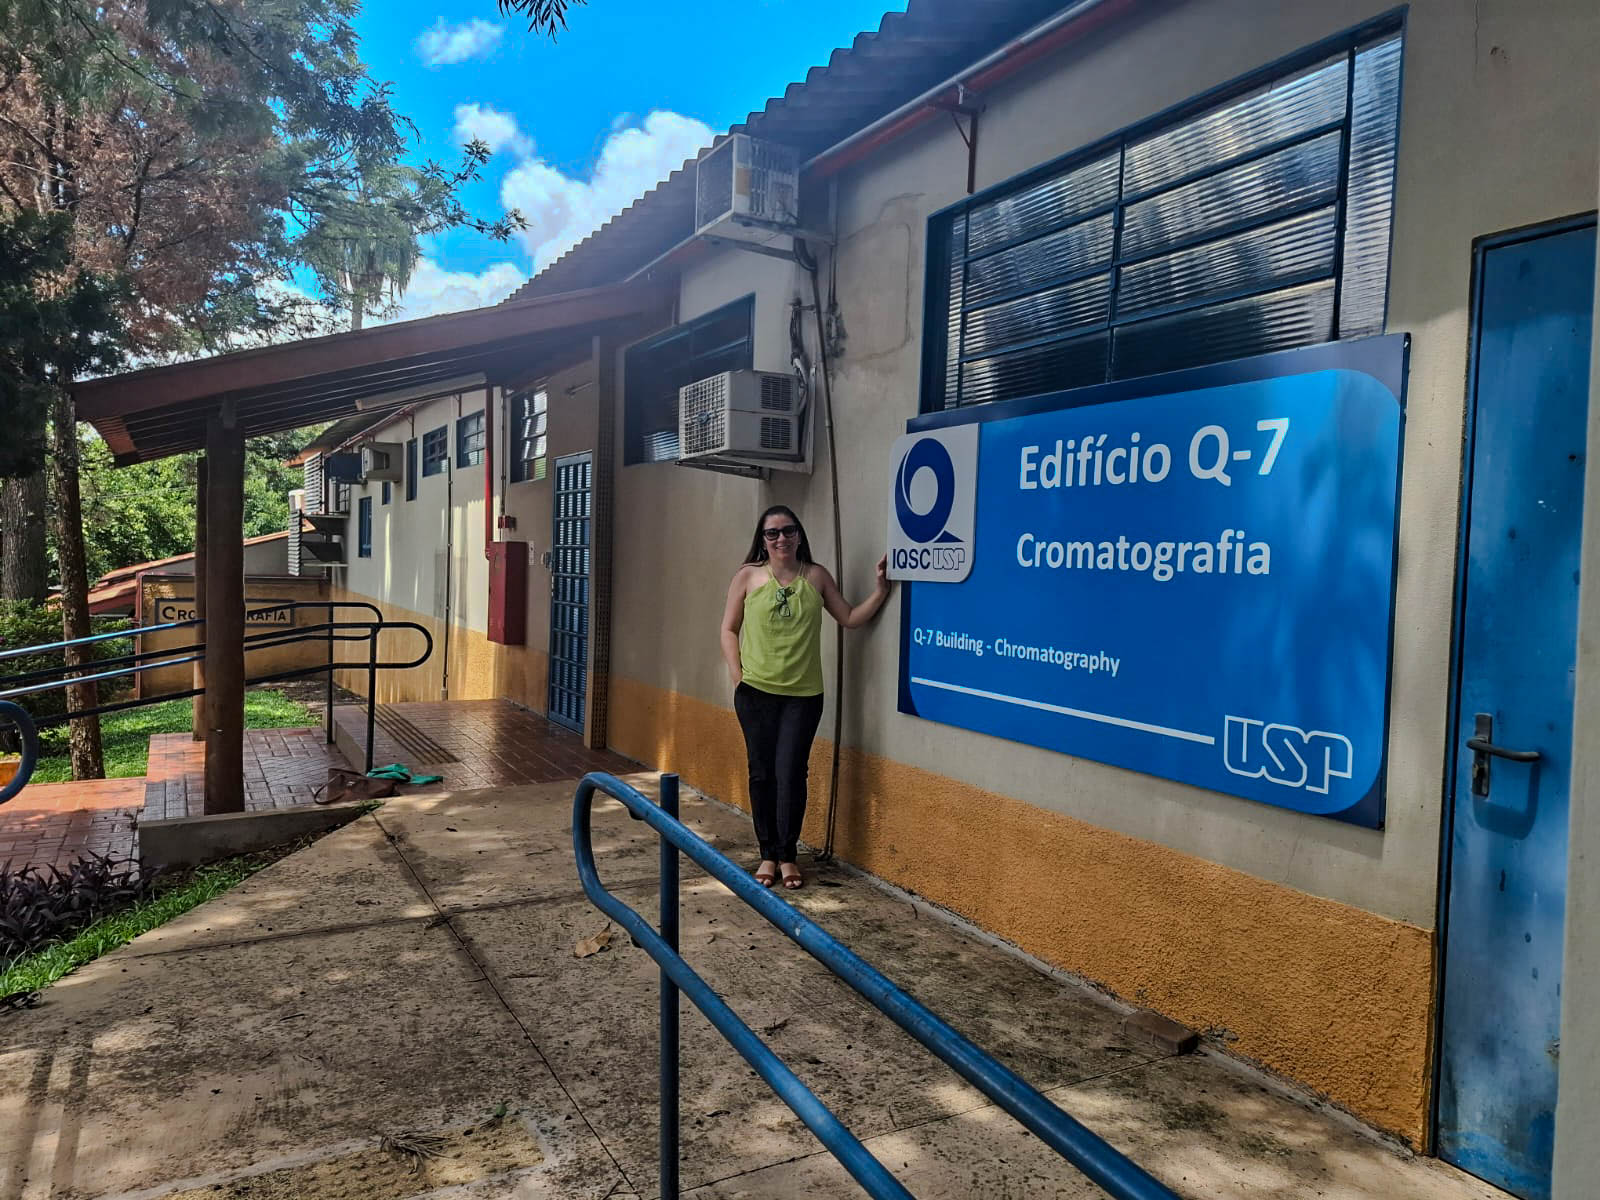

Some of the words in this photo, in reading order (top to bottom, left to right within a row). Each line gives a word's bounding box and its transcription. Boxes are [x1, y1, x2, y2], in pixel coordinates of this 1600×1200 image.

[1019, 432, 1172, 490] Edifício
[1188, 417, 1291, 487] Q-7
[892, 547, 930, 569] IQSC
[932, 547, 965, 571] USP
[1016, 528, 1272, 582] Cromatografia
[913, 627, 934, 645] Q-7
[936, 631, 984, 657] Building
[994, 638, 1121, 678] Chromatography
[1223, 714, 1354, 795] USP
